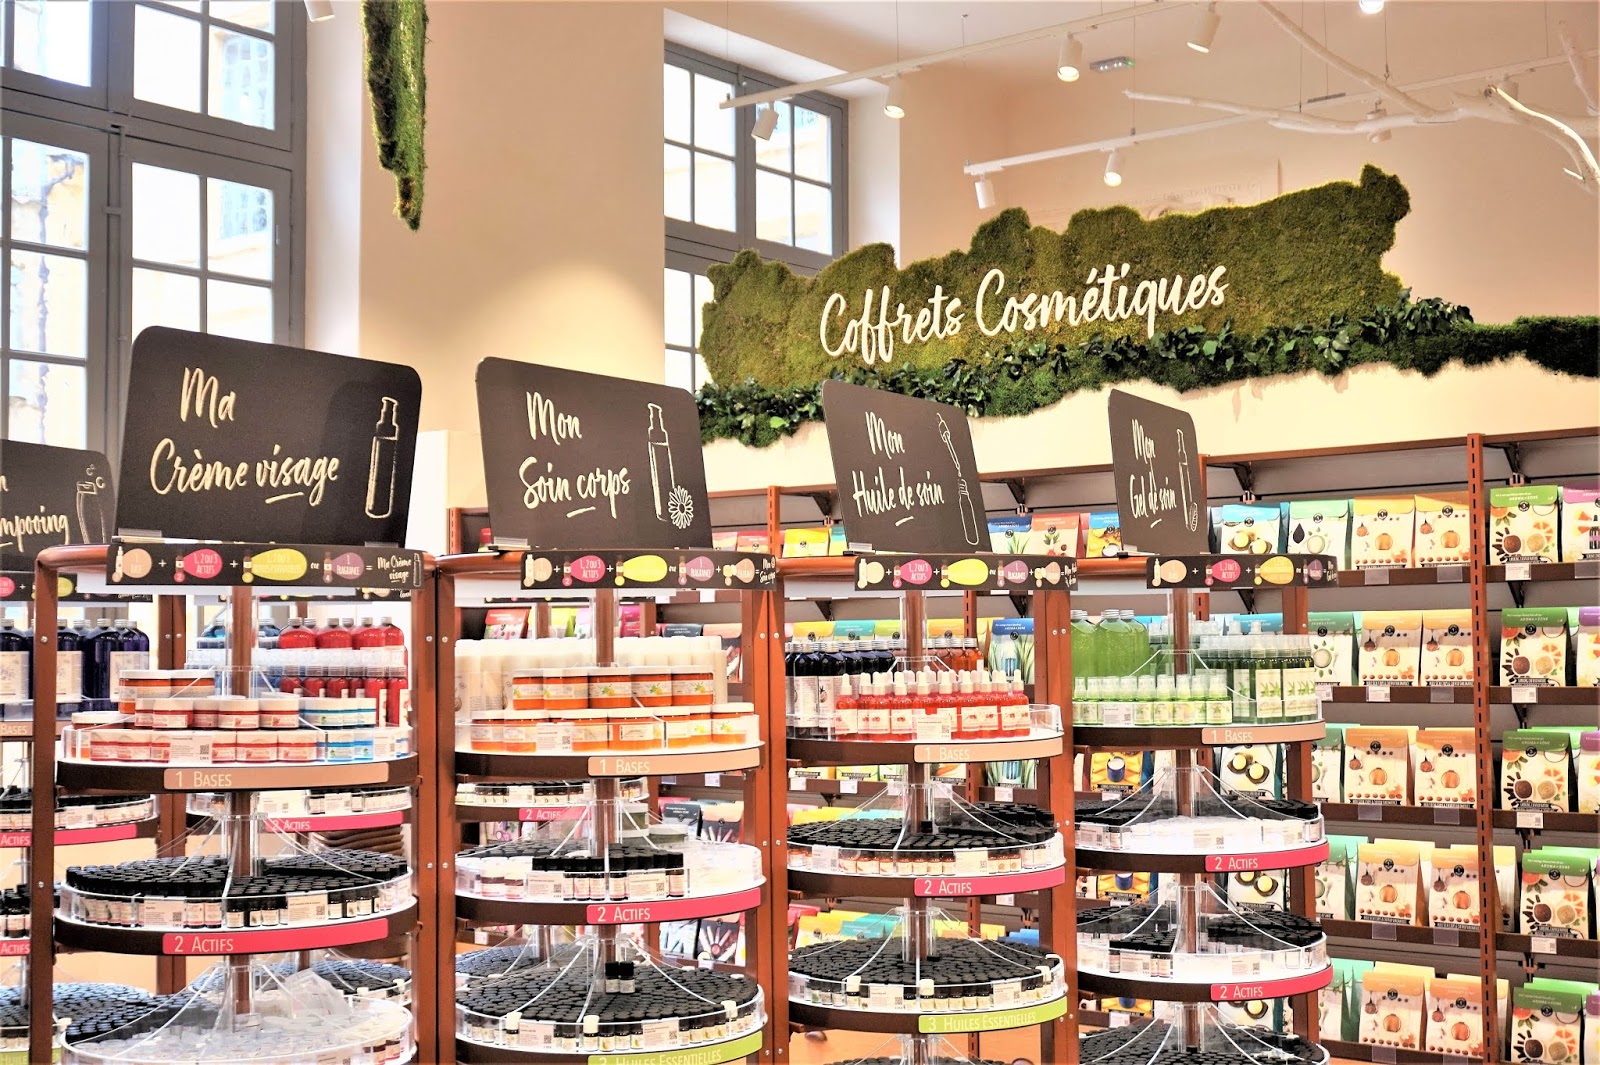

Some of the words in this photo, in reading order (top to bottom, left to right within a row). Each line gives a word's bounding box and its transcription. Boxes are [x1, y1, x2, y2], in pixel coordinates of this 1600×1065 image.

[820, 285, 966, 365] Coffrets
[976, 263, 1230, 340] Cosmétiques
[180, 367, 237, 428] Ma
[526, 391, 583, 446] Mon
[865, 411, 905, 459] Mon
[1131, 419, 1156, 464] Mon
[150, 438, 247, 495] Crème
[255, 444, 340, 506] visage
[519, 456, 572, 509] Soin
[576, 467, 631, 519] corps
[852, 466, 896, 517] Huile
[899, 467, 915, 511] de
[916, 471, 945, 506] soin
[1129, 474, 1149, 519] Gel
[1148, 471, 1159, 515] de
[1159, 476, 1177, 511] soin
[1211, 730, 1217, 743] 1
[1225, 730, 1253, 743] BASES
[924, 747, 931, 760] 1
[939, 747, 970, 760] BASES
[599, 759, 606, 774] 1
[615, 759, 650, 774] BASES
[175, 771, 184, 788] 1
[193, 771, 232, 788] BASES
[526, 809, 533, 820] 2
[1214, 857, 1222, 870] 2
[1228, 857, 1258, 870] ACTIFS
[924, 880, 932, 894] 2
[939, 880, 972, 894] ACTIFS
[597, 907, 606, 922] 2
[613, 906, 651, 922] ACTIFS
[174, 936, 184, 953] 2
[191, 936, 234, 953] ACTIFS
[1220, 986, 1228, 999] 2
[1233, 985, 1263, 999] ACTIFS
[928, 1017, 937, 1032] 3
[943, 1016, 980, 1032] HUILES
[982, 1011, 1036, 1030] ESSENTIELLES
